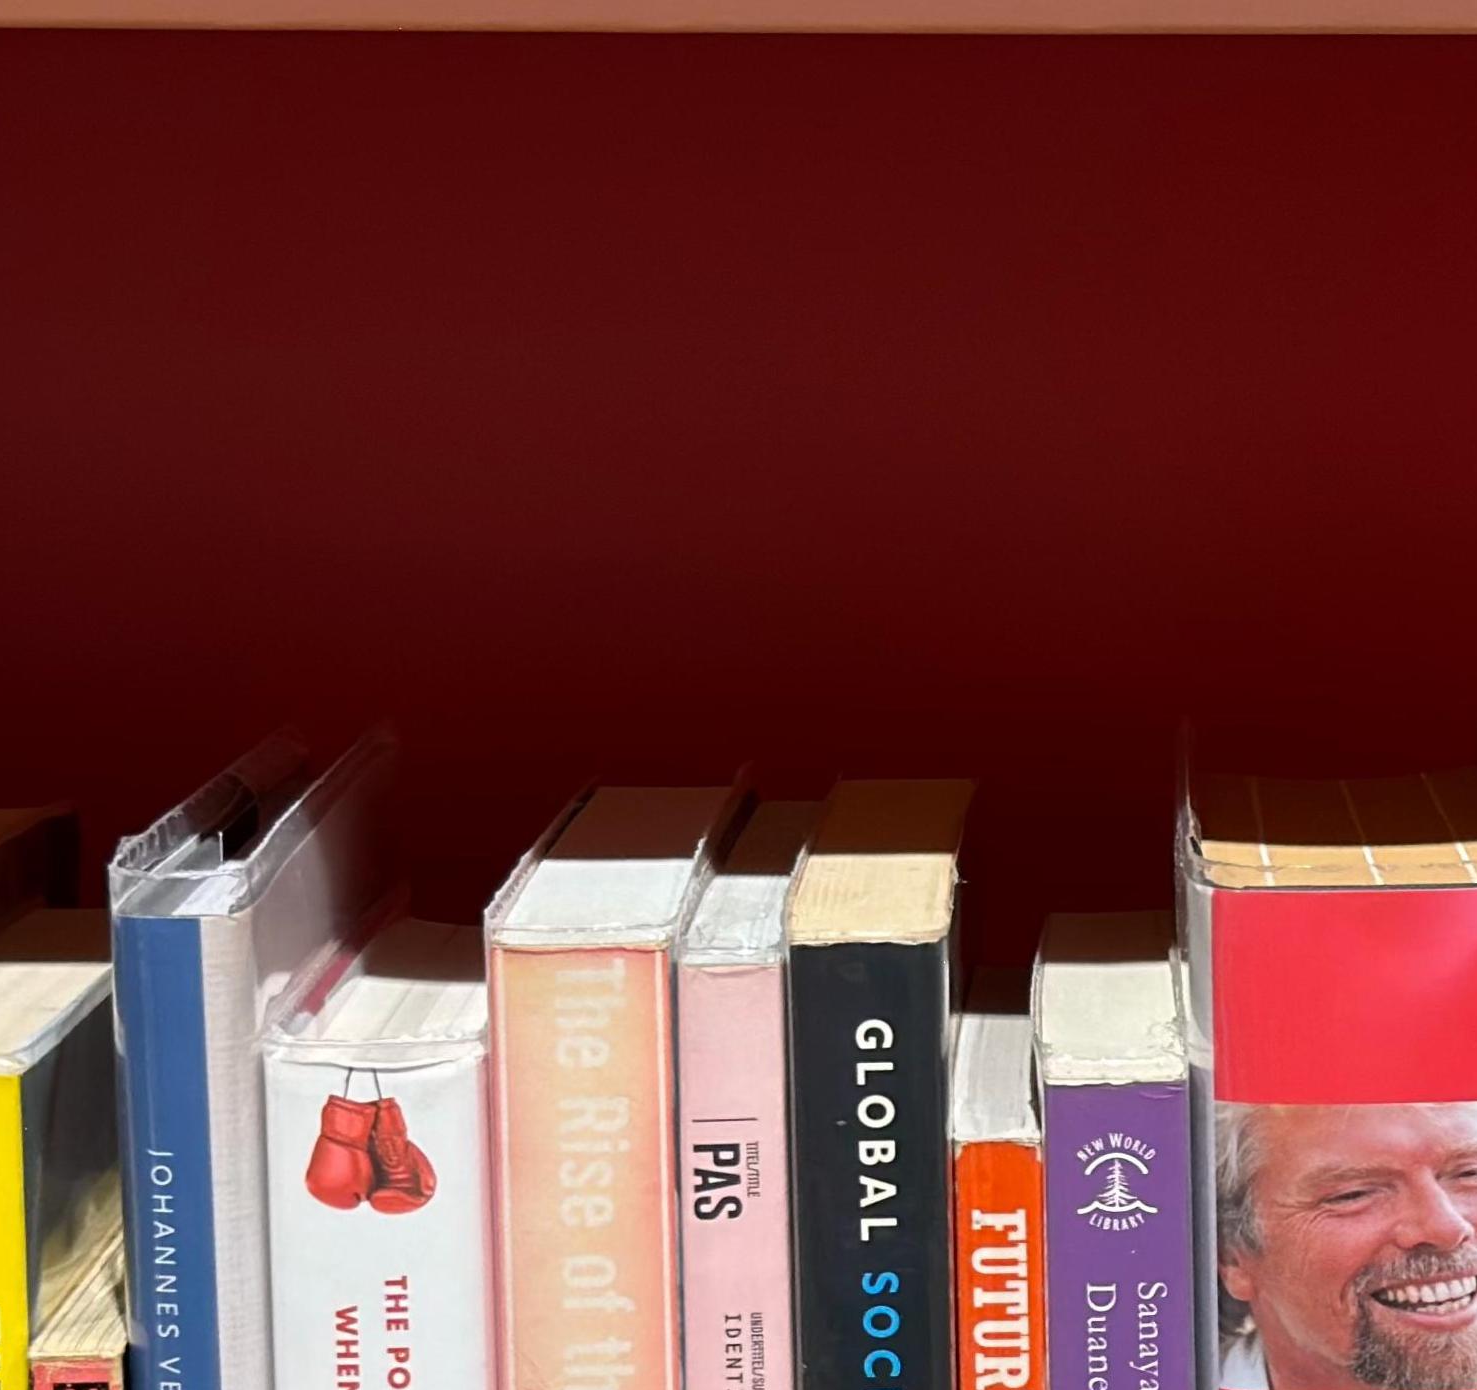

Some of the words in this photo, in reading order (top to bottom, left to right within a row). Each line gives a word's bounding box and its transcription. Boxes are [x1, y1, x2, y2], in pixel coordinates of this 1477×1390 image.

[692, 1143, 742, 1220] PAS
[855, 1019, 897, 1243] GLOBAL
[149, 1150, 179, 1339] JOHANNES
[385, 1275, 408, 1331] THE
